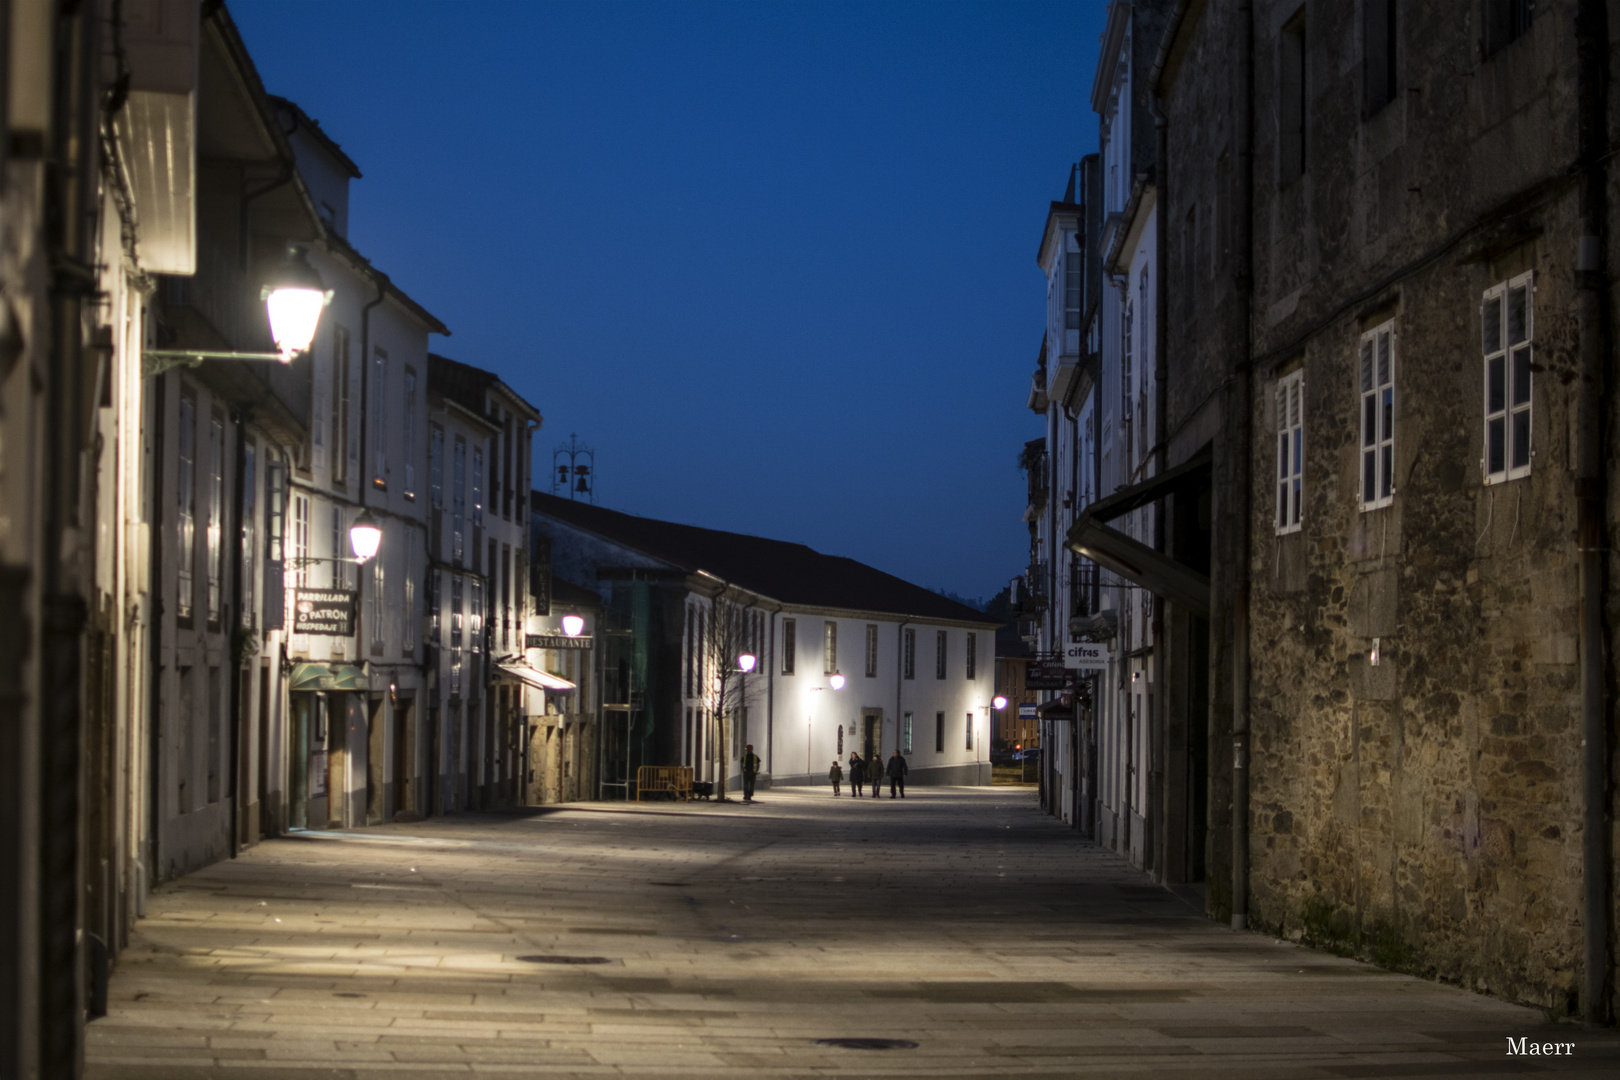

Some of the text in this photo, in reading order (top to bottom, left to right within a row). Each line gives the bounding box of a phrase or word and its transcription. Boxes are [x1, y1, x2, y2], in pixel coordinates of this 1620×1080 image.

[297, 593, 350, 602] PARRILLADA
[299, 614, 307, 622] O
[296, 622, 338, 631] HOSPEDAJE
[527, 638, 590, 647] RESTAURANTE
